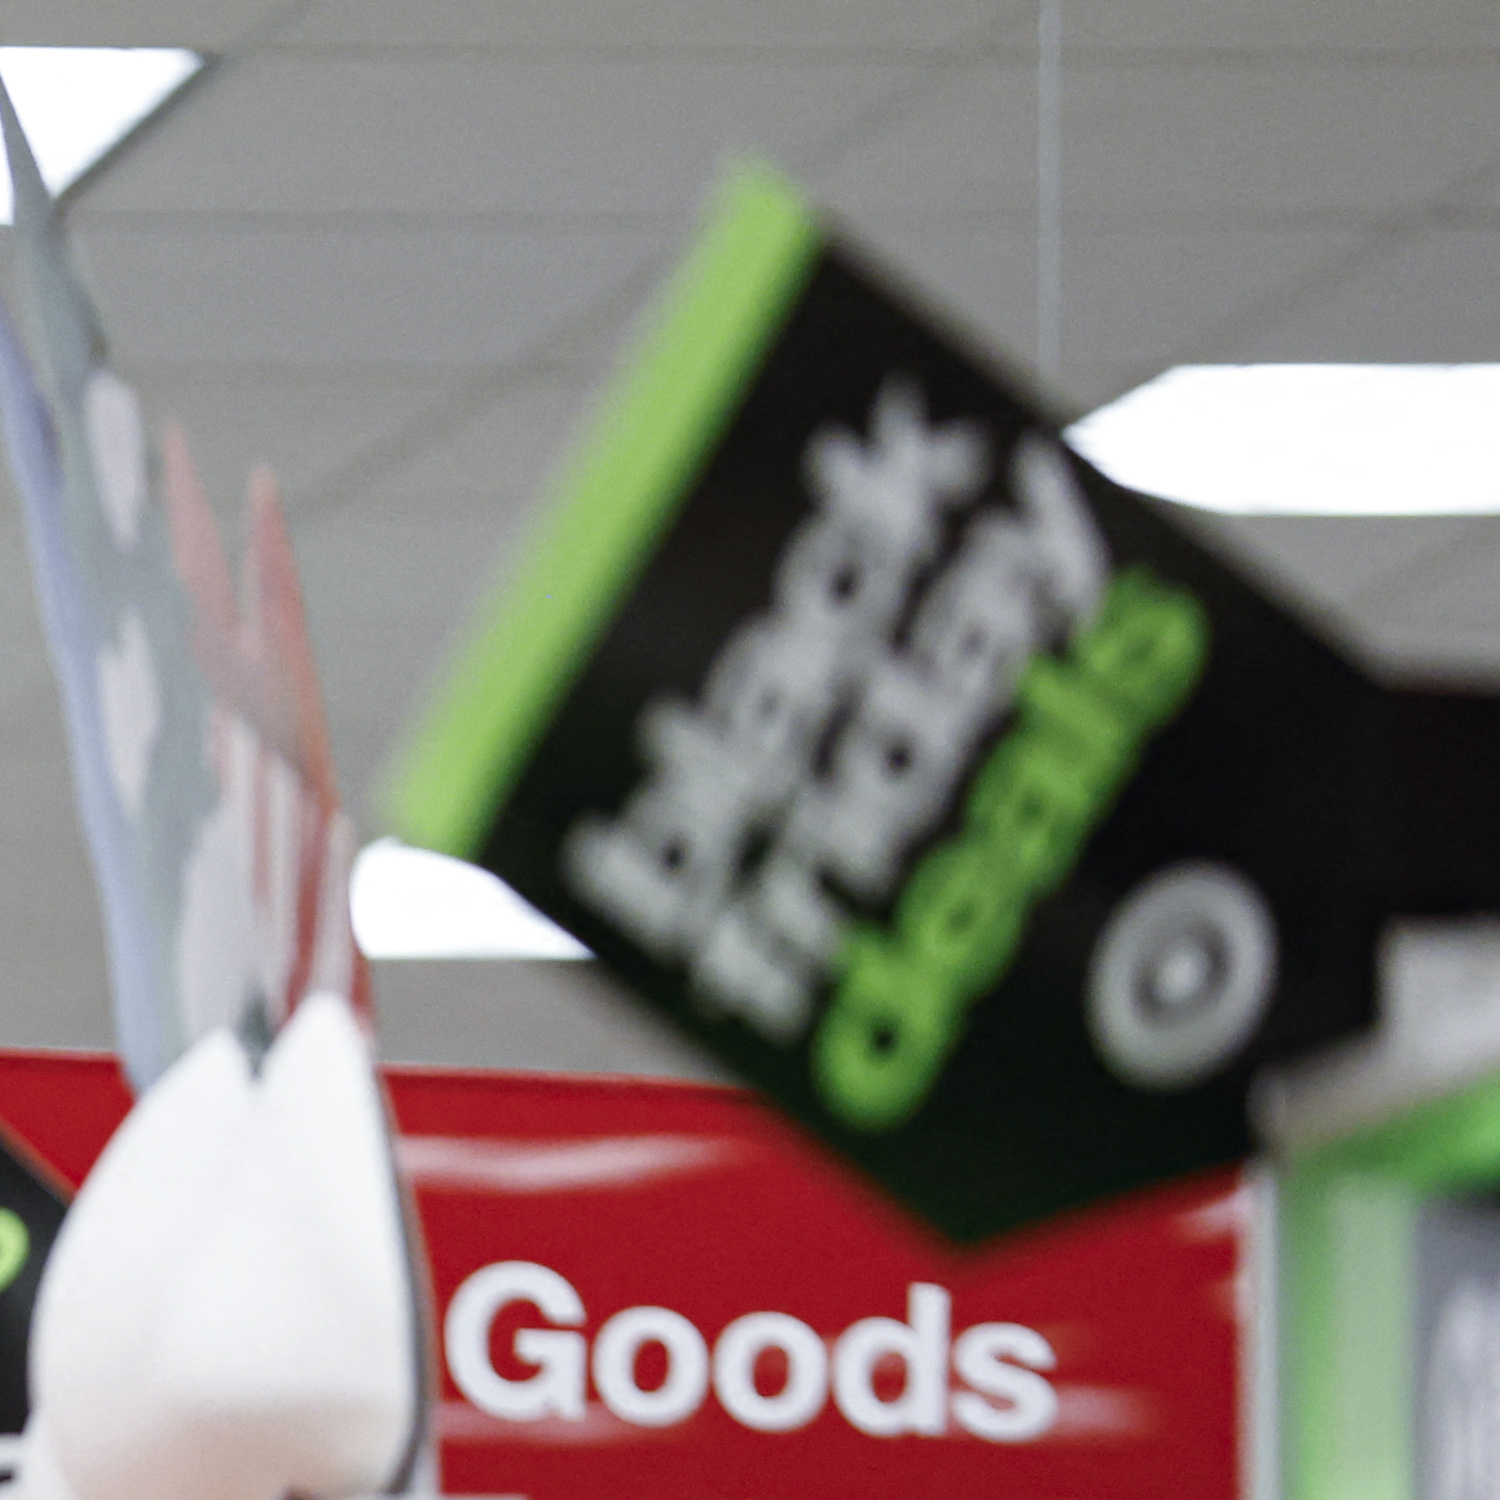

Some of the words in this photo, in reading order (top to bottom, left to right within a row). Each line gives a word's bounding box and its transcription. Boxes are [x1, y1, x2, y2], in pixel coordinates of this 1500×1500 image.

[562, 376, 989, 962] black
[689, 433, 1111, 1042] friday
[811, 564, 1209, 1131] deals
[444, 1259, 1058, 1444] Goods
